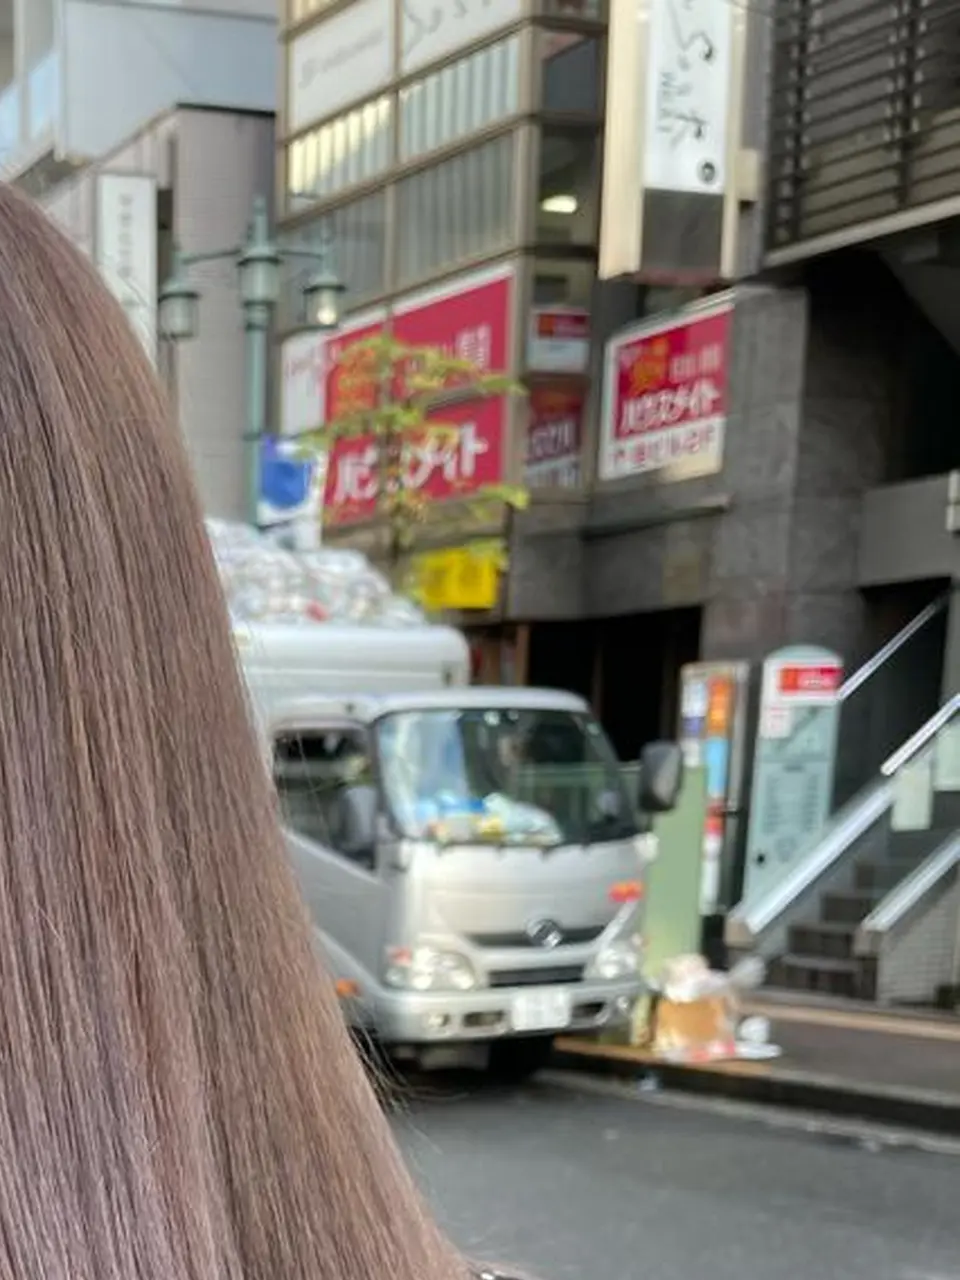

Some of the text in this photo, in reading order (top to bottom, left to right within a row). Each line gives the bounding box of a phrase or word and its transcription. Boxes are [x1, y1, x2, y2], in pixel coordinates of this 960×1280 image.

[333, 420, 489, 504] ハウメイト
